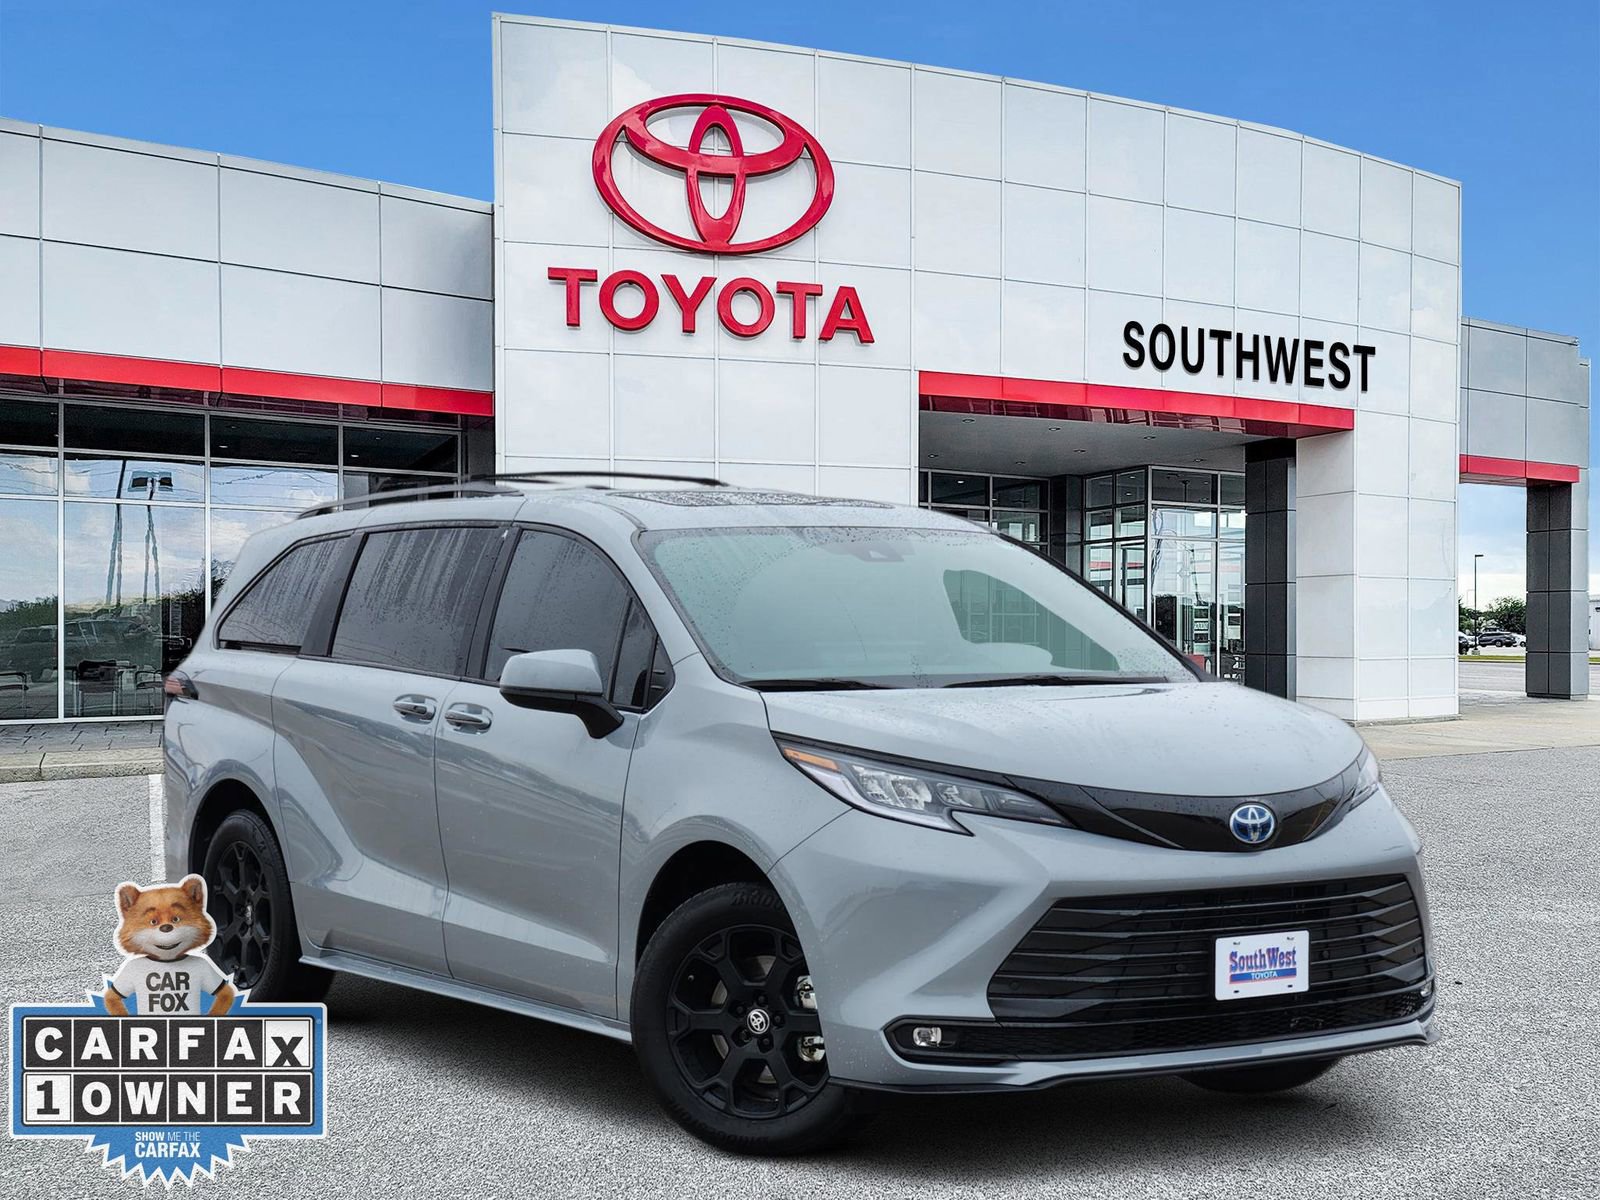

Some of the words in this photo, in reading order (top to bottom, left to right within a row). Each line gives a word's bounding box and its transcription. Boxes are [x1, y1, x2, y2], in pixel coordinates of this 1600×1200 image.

[548, 266, 875, 344] TOYOTA
[1122, 320, 1376, 393] SOUTHWEST
[1250, 970, 1279, 980] TOYOTA
